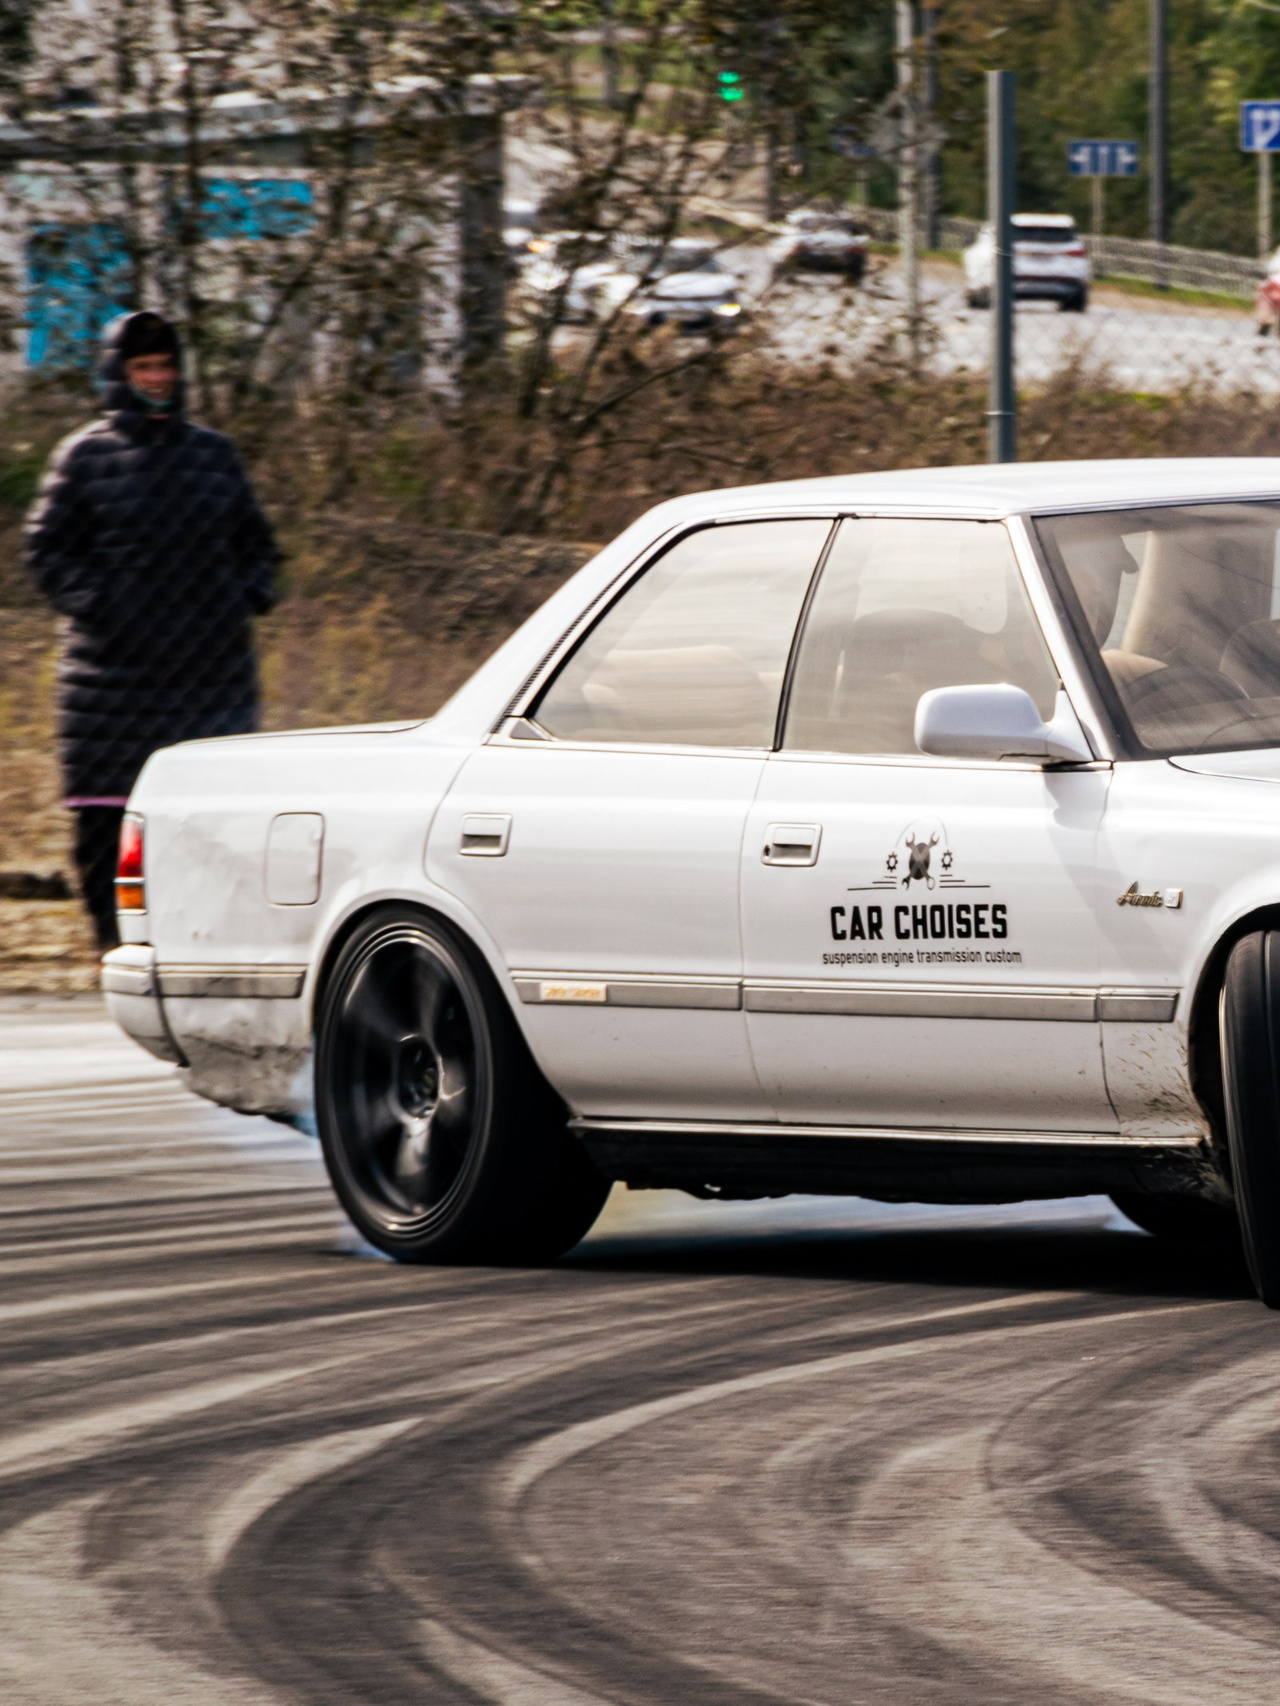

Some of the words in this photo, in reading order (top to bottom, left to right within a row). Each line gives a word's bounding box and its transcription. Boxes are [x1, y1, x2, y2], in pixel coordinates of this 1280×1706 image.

[831, 905, 884, 941] CAR
[894, 903, 1008, 940] CHOISES
[822, 949, 879, 968] suspension
[881, 948, 915, 966] engine
[916, 948, 983, 964] transmission
[984, 948, 1023, 964] custom
